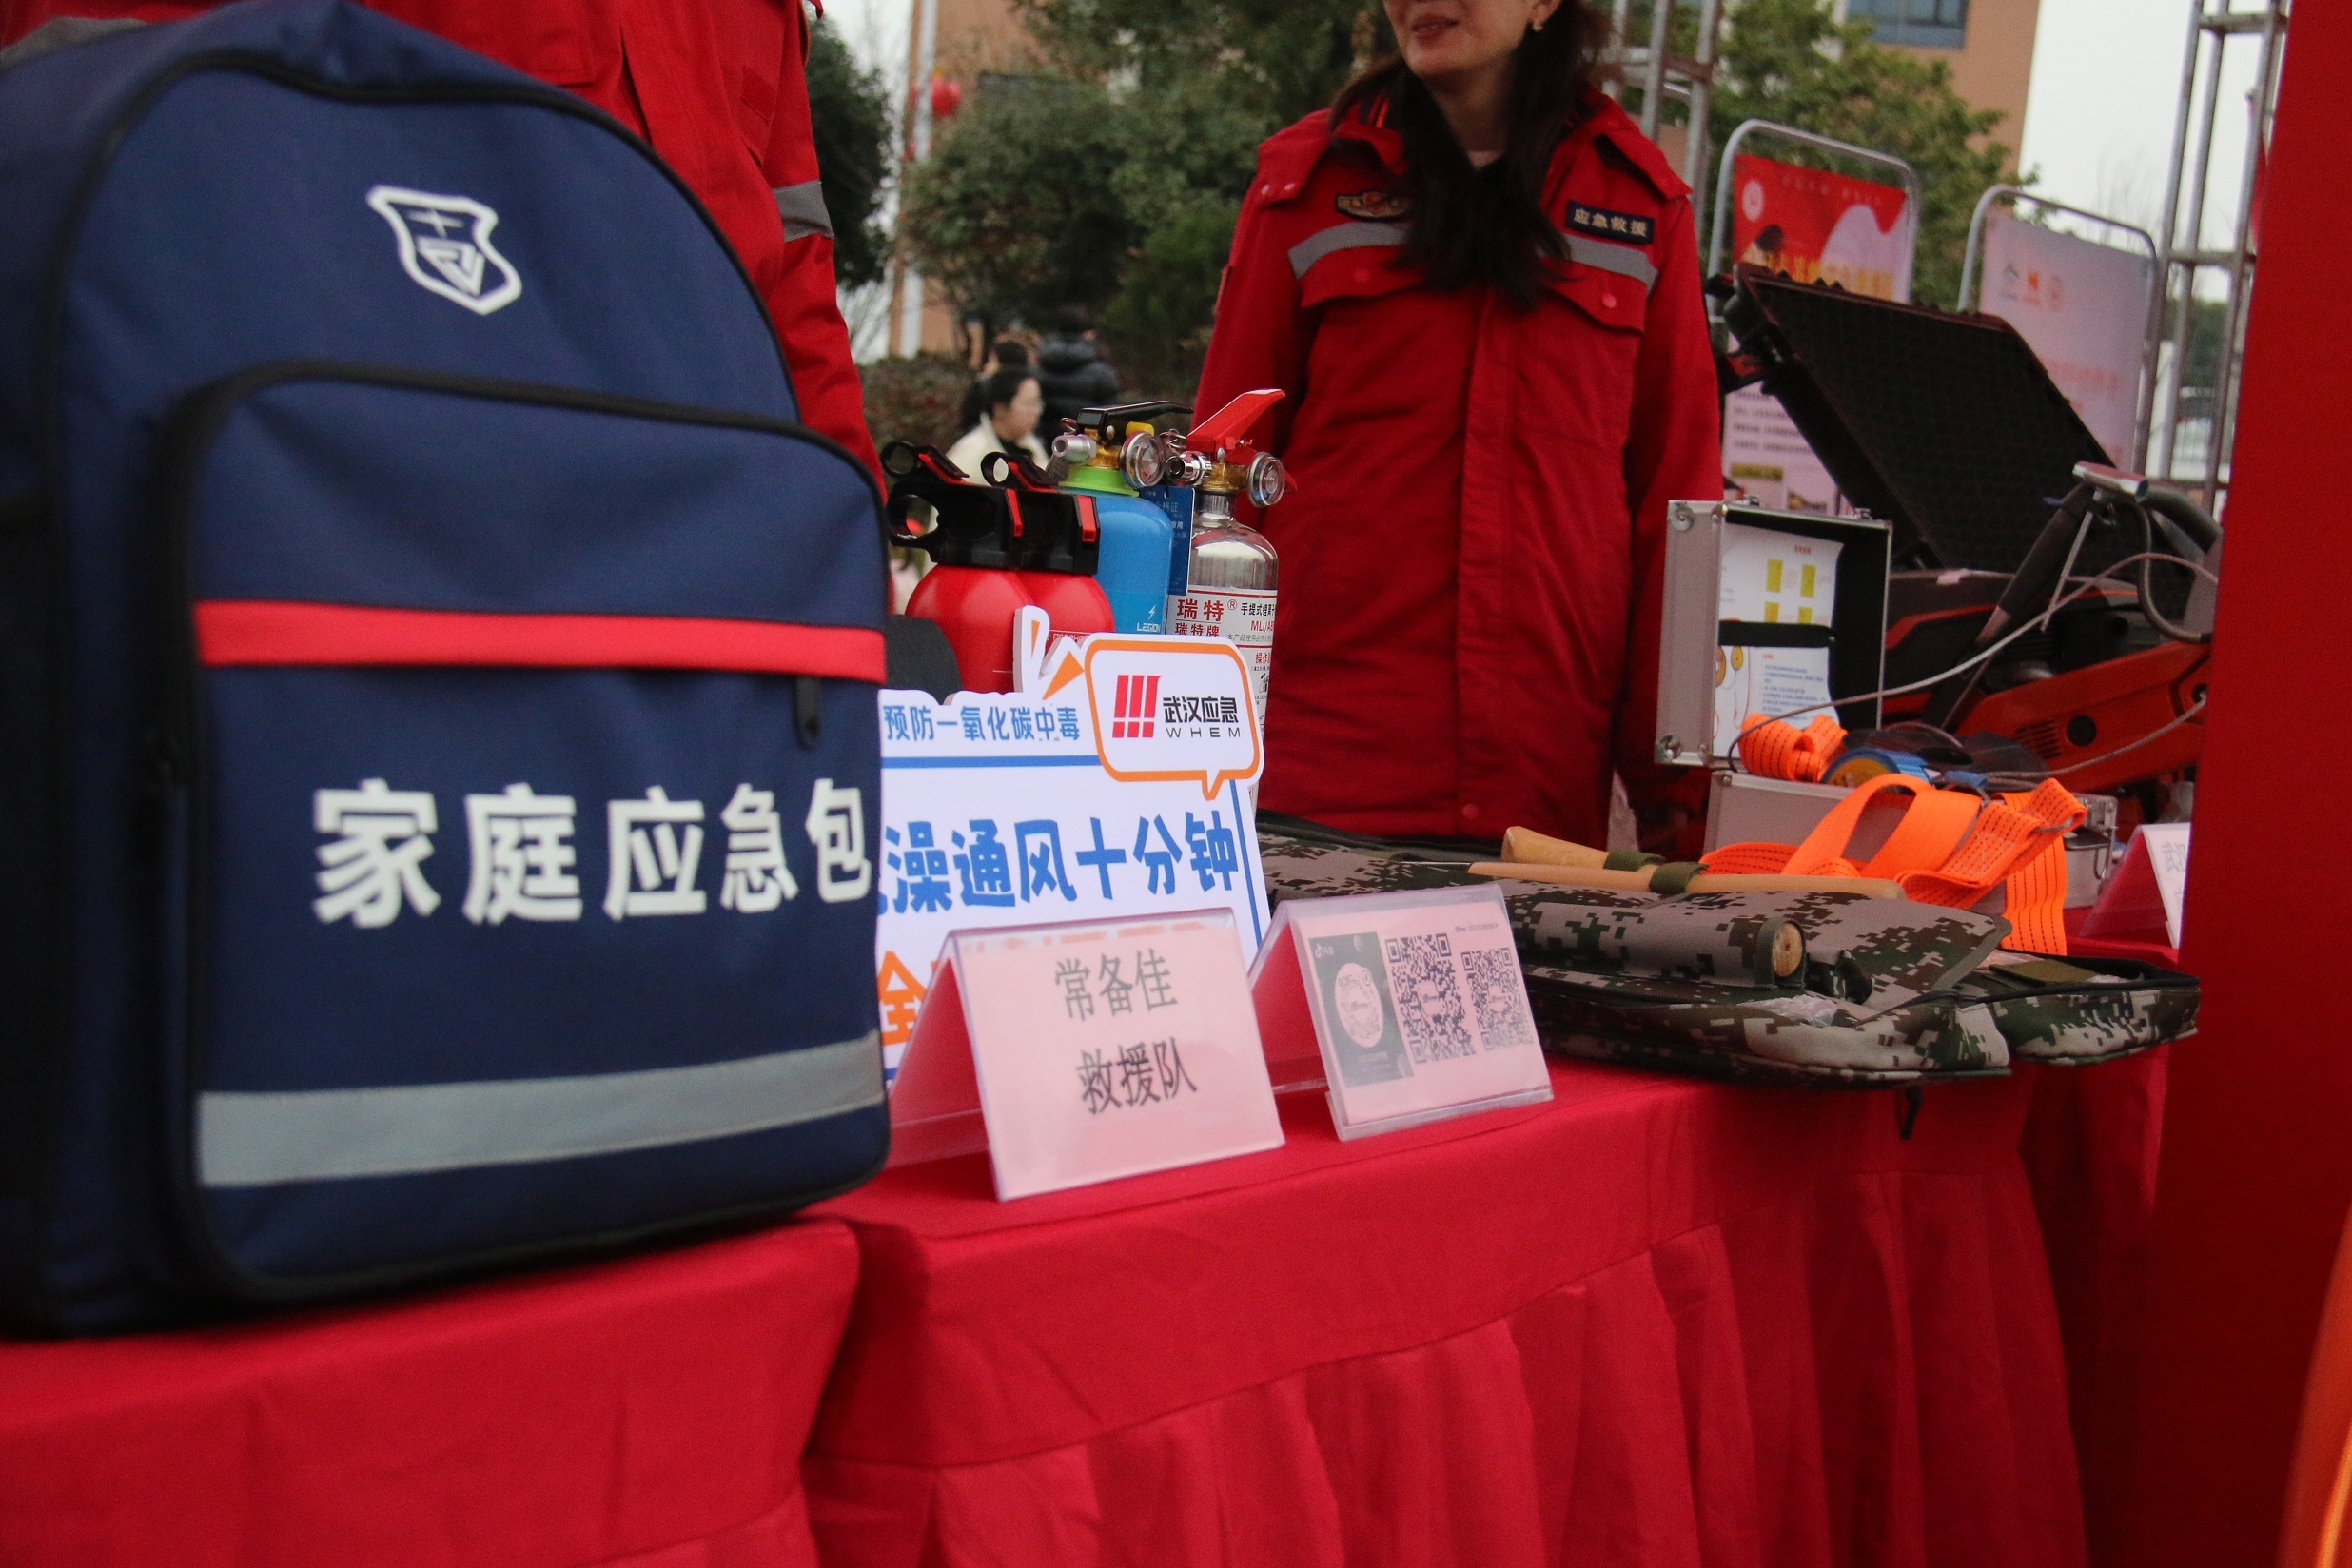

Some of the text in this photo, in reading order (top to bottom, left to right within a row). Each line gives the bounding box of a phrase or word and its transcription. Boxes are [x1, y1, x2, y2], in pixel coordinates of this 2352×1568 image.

[1574, 208, 1648, 238] 应急救援
[1177, 598, 1225, 622] 瑞特
[883, 704, 1081, 742] 预防一氧化碳中毒
[1163, 696, 1239, 723] 武汉应急
[1166, 727, 1241, 739] WHEM
[312, 777, 872, 928] 家庭应急包
[877, 809, 1239, 916] 澡通风十分钟
[877, 949, 938, 1046] 全
[1054, 948, 1179, 1023] 常备佳
[1076, 1036, 1198, 1116] 救援队
